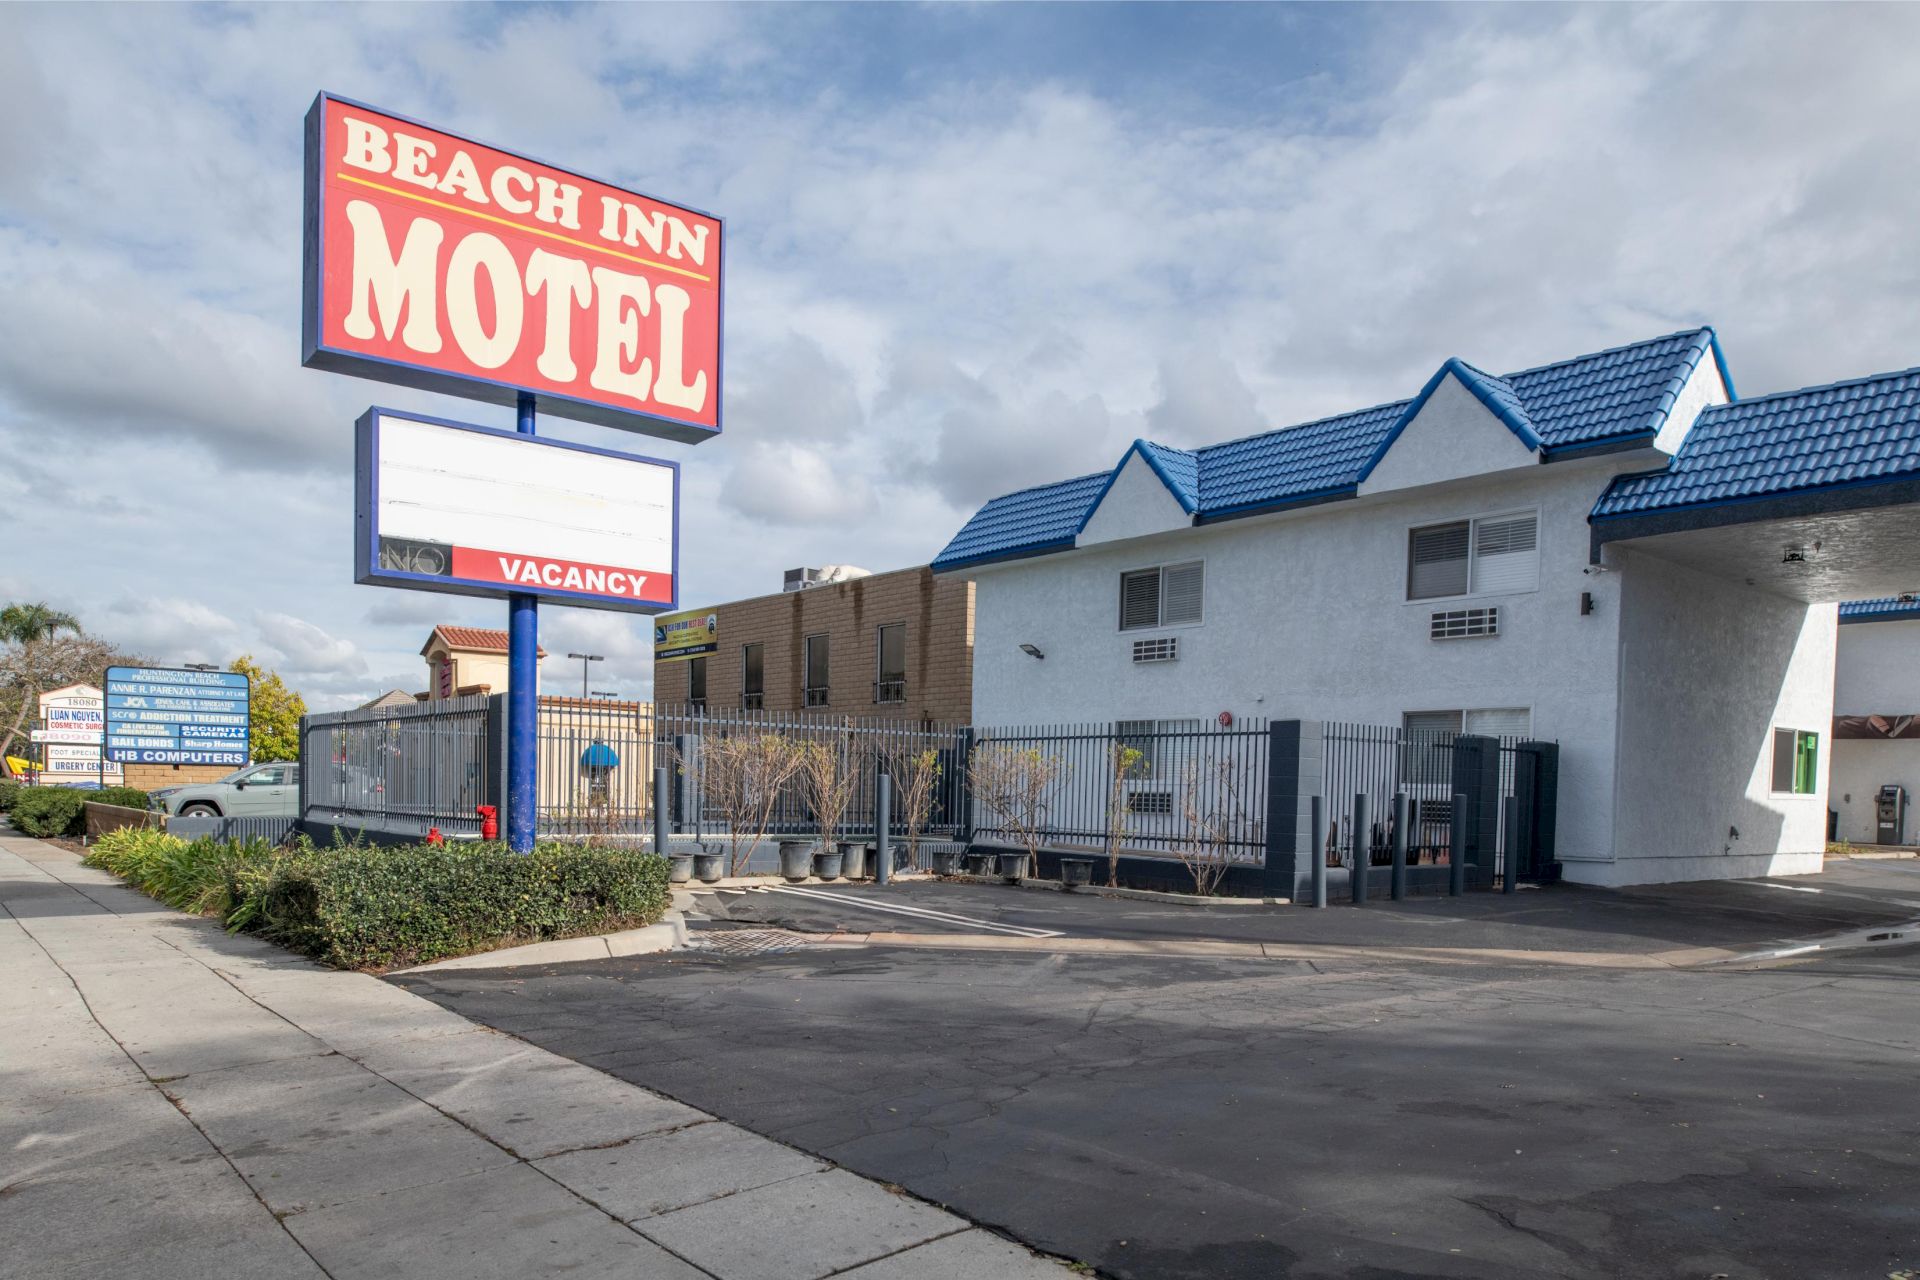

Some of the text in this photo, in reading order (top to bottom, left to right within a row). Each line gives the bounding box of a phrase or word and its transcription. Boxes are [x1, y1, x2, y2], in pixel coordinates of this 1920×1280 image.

[343, 117, 709, 265] BEACH INN
[343, 200, 707, 413] MOTEL
[383, 544, 648, 597] NO VACANCY
[139, 669, 193, 678] HUNTINGTON
[132, 674, 226, 686] PROFESSIONAL BUILDING
[111, 683, 136, 693] ANNIE
[139, 685, 147, 693] R.
[150, 685, 196, 696] PARENZAN
[198, 689, 224, 697] ATTORNEY
[68, 698, 97, 706] 18080
[123, 697, 148, 708] JCA
[50, 709, 70, 720] LUAN
[140, 712, 192, 722] ADDICTION
[193, 714, 245, 724] TREATMENT
[112, 737, 174, 748] BAIL BONDS
[184, 740, 213, 749] Sharp
[114, 750, 244, 763] HB COMPUTERS
